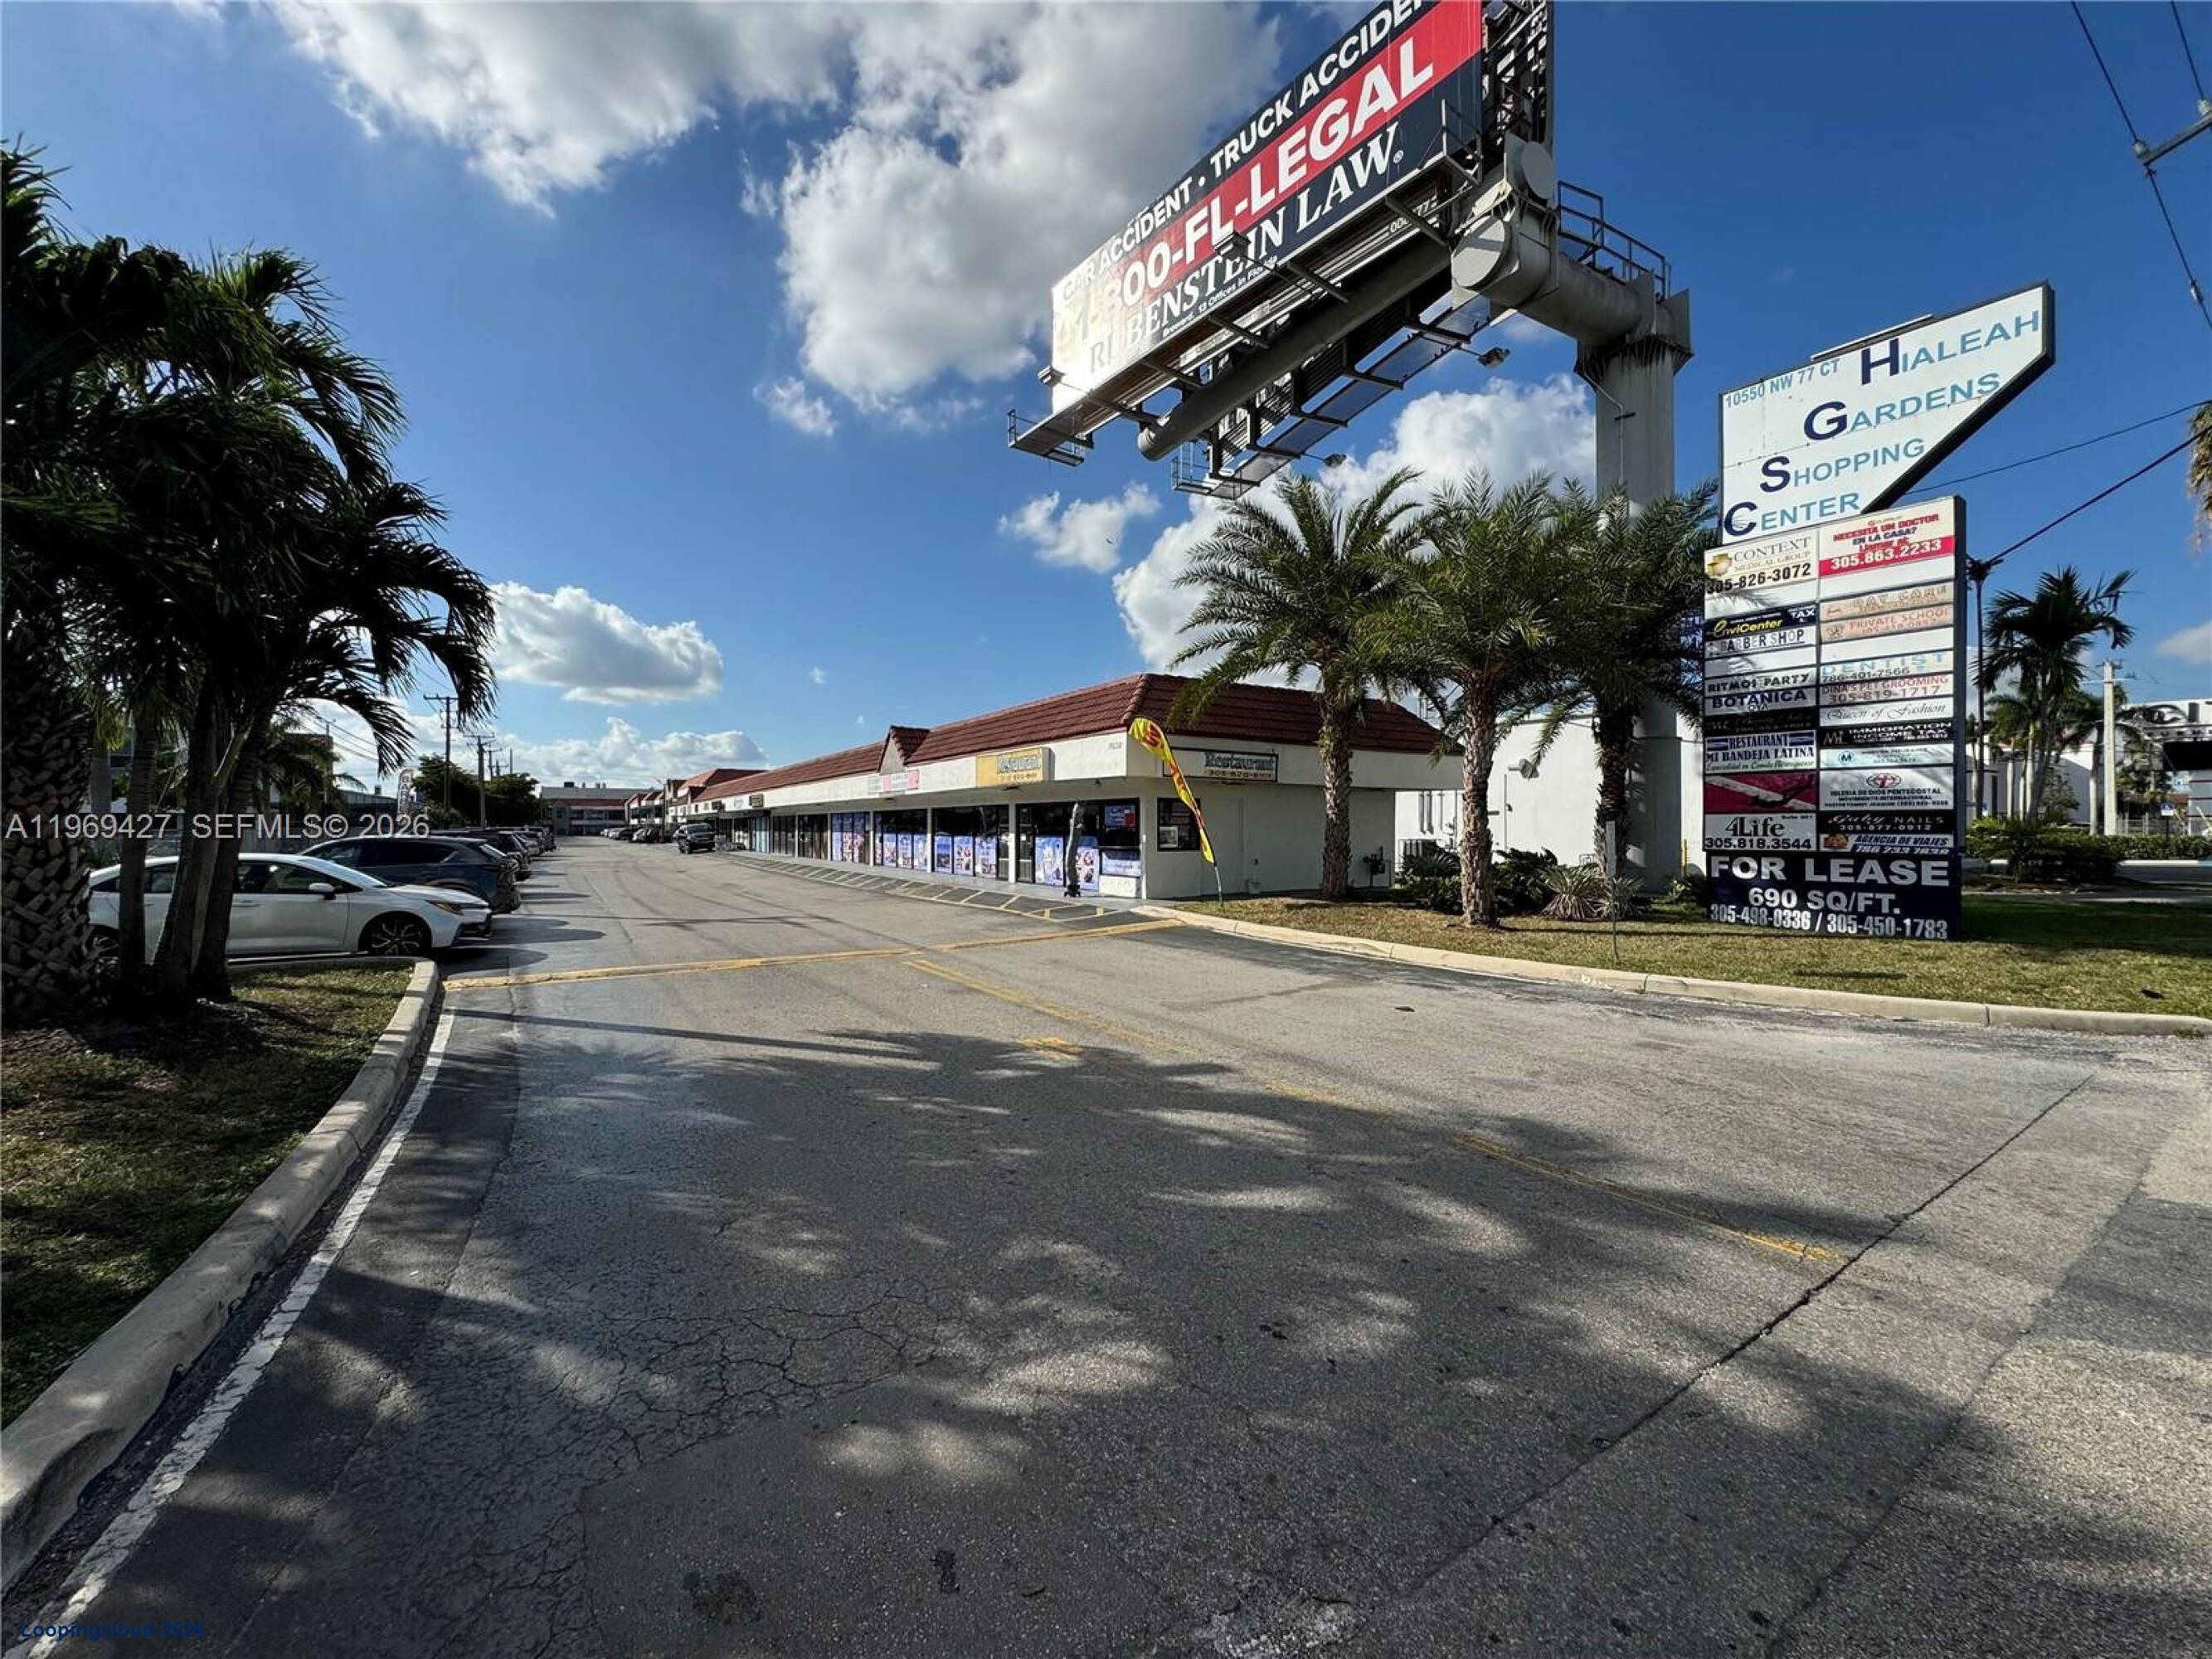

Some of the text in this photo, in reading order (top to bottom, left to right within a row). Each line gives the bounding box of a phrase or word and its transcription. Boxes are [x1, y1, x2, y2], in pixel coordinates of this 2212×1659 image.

[1098, 173, 1191, 273] ACCIDENT
[1208, 90, 1294, 178] TRUCK
[1299, 0, 1423, 109] ACCIDE
[1860, 310, 2039, 385] HIALEAH
[1725, 358, 1840, 408] 10550 NW 77 CT
[1803, 372, 2001, 440] GARDENS
[1759, 437, 1925, 492] SHOPPING
[1723, 493, 1860, 536] CENTER
[1833, 527, 1878, 541] NECESITA
[1880, 521, 1896, 532] UN
[1898, 513, 1939, 528] DOCTOR
[1869, 534, 1881, 542] LA
[1884, 526, 1918, 539] CASA?
[1733, 536, 1811, 562] CONTEXT
[1830, 539, 1942, 570] 305.863.2233
[1707, 562, 1811, 593] 305-826-3072
[1791, 608, 1815, 619] TAX
[1902, 608, 1949, 622] SCHOOL
[1721, 629, 1805, 652] BARBER SHOP
[1822, 652, 1947, 675] DENTIST
[1763, 673, 1810, 687] PARTY
[1860, 680, 1879, 692] PET
[1882, 674, 1949, 689] GROOMING
[1712, 690, 1807, 708] BOTANICA
[1871, 707, 1885, 720] of
[1887, 703, 1946, 719] Fashion
[1849, 722, 1952, 735] IMMIGRATION
[1728, 733, 1788, 749] RESTAURANT
[1722, 748, 1771, 761] BANDEJA
[1774, 747, 1814, 759] LATINA
[1725, 816, 1785, 837] 4Life
[1705, 838, 1812, 849] 305.818.3544
[1913, 836, 1949, 846] VIAJES
[1709, 855, 1950, 887] FOR LEASE
[1748, 887, 1901, 915] 690 SQ/FT.
[1709, 903, 1948, 940] 305-498-0336 / 305-450-1783
